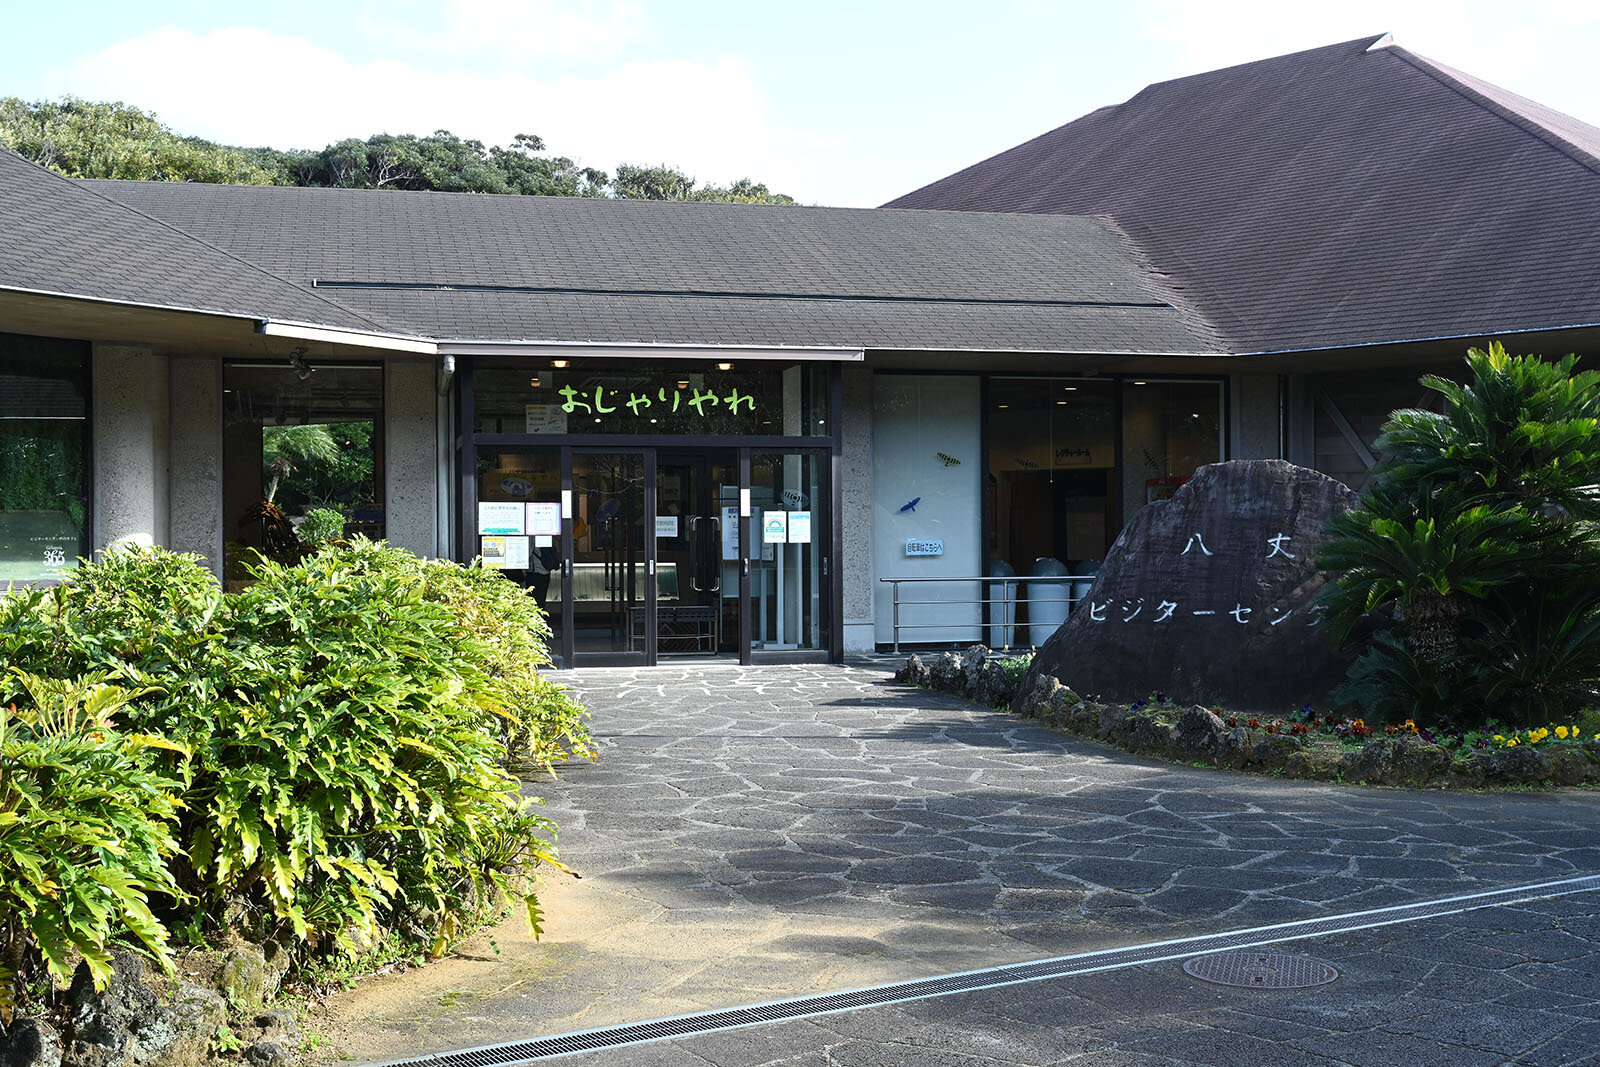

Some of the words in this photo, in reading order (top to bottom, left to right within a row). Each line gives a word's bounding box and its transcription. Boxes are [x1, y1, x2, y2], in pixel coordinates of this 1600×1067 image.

[558, 384, 757, 417] おじゃりやれ
[907, 542, 943, 552] 自転車はこちらへ
[1181, 532, 1296, 559] 八丈
[43, 550, 65, 567] 365
